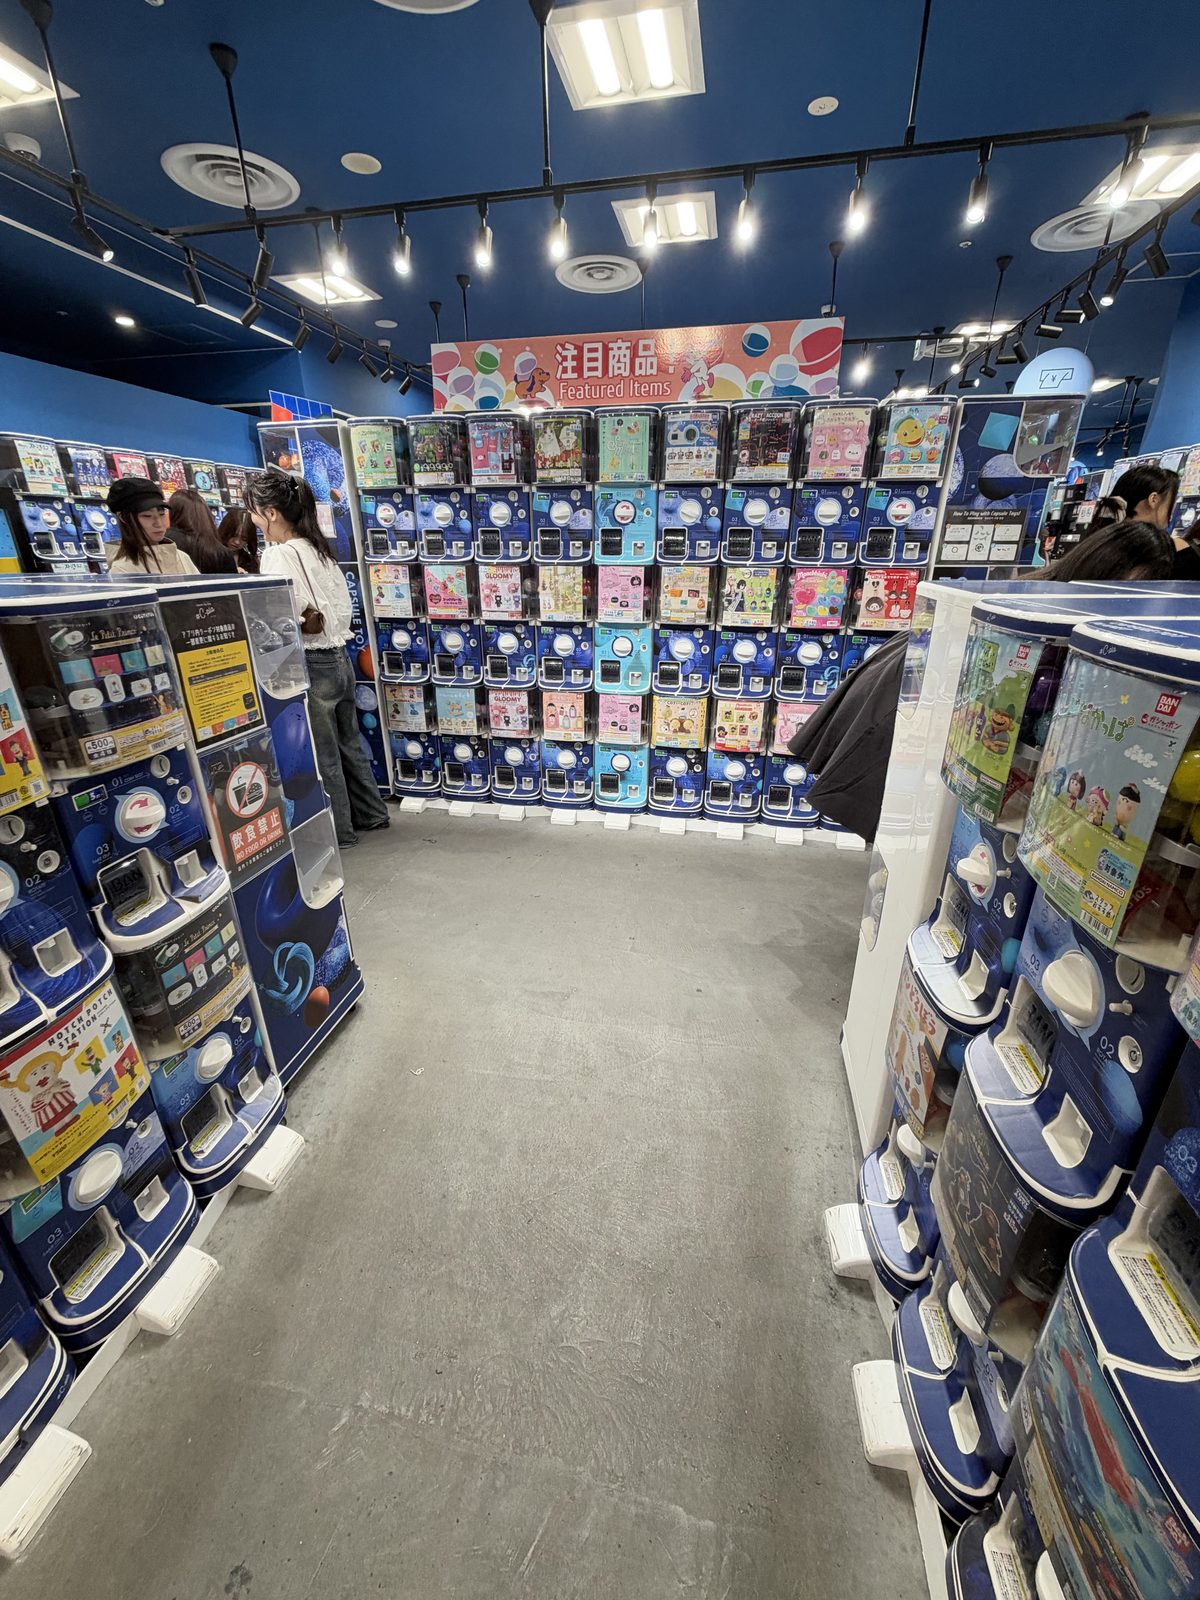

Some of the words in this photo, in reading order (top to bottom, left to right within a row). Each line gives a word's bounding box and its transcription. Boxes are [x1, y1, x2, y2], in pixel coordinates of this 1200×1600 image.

[560, 379, 624, 400] Featured
[630, 379, 671, 397] Items
[345, 571, 362, 625] CAPSULE
[354, 627, 366, 652] TOY
[1157, 703, 1172, 713] DAI
[1160, 695, 1180, 707] BAN
[91, 738, 109, 749] 500
[112, 776, 123, 787] 01
[169, 804, 180, 815] 02
[232, 811, 281, 850] 飲食禁止
[96, 843, 110, 855] 03
[236, 851, 245, 860] NO
[245, 843, 259, 854] FOOD
[259, 837, 267, 845] OR
[267, 829, 282, 842] DRINK
[25, 874, 41, 888] 02
[1030, 955, 1041, 971] 03
[48, 1016, 84, 1047] HOTCH
[86, 988, 114, 1016] POTCH
[183, 1018, 196, 1031] 500
[58, 1013, 98, 1050] STATION
[233, 1035, 243, 1046] 02
[1100, 1035, 1115, 1057] 02
[180, 1093, 190, 1106] 03
[128, 1141, 140, 1155] 02
[1178, 1145, 1198, 1174] 03
[47, 1227, 63, 1245] 03
